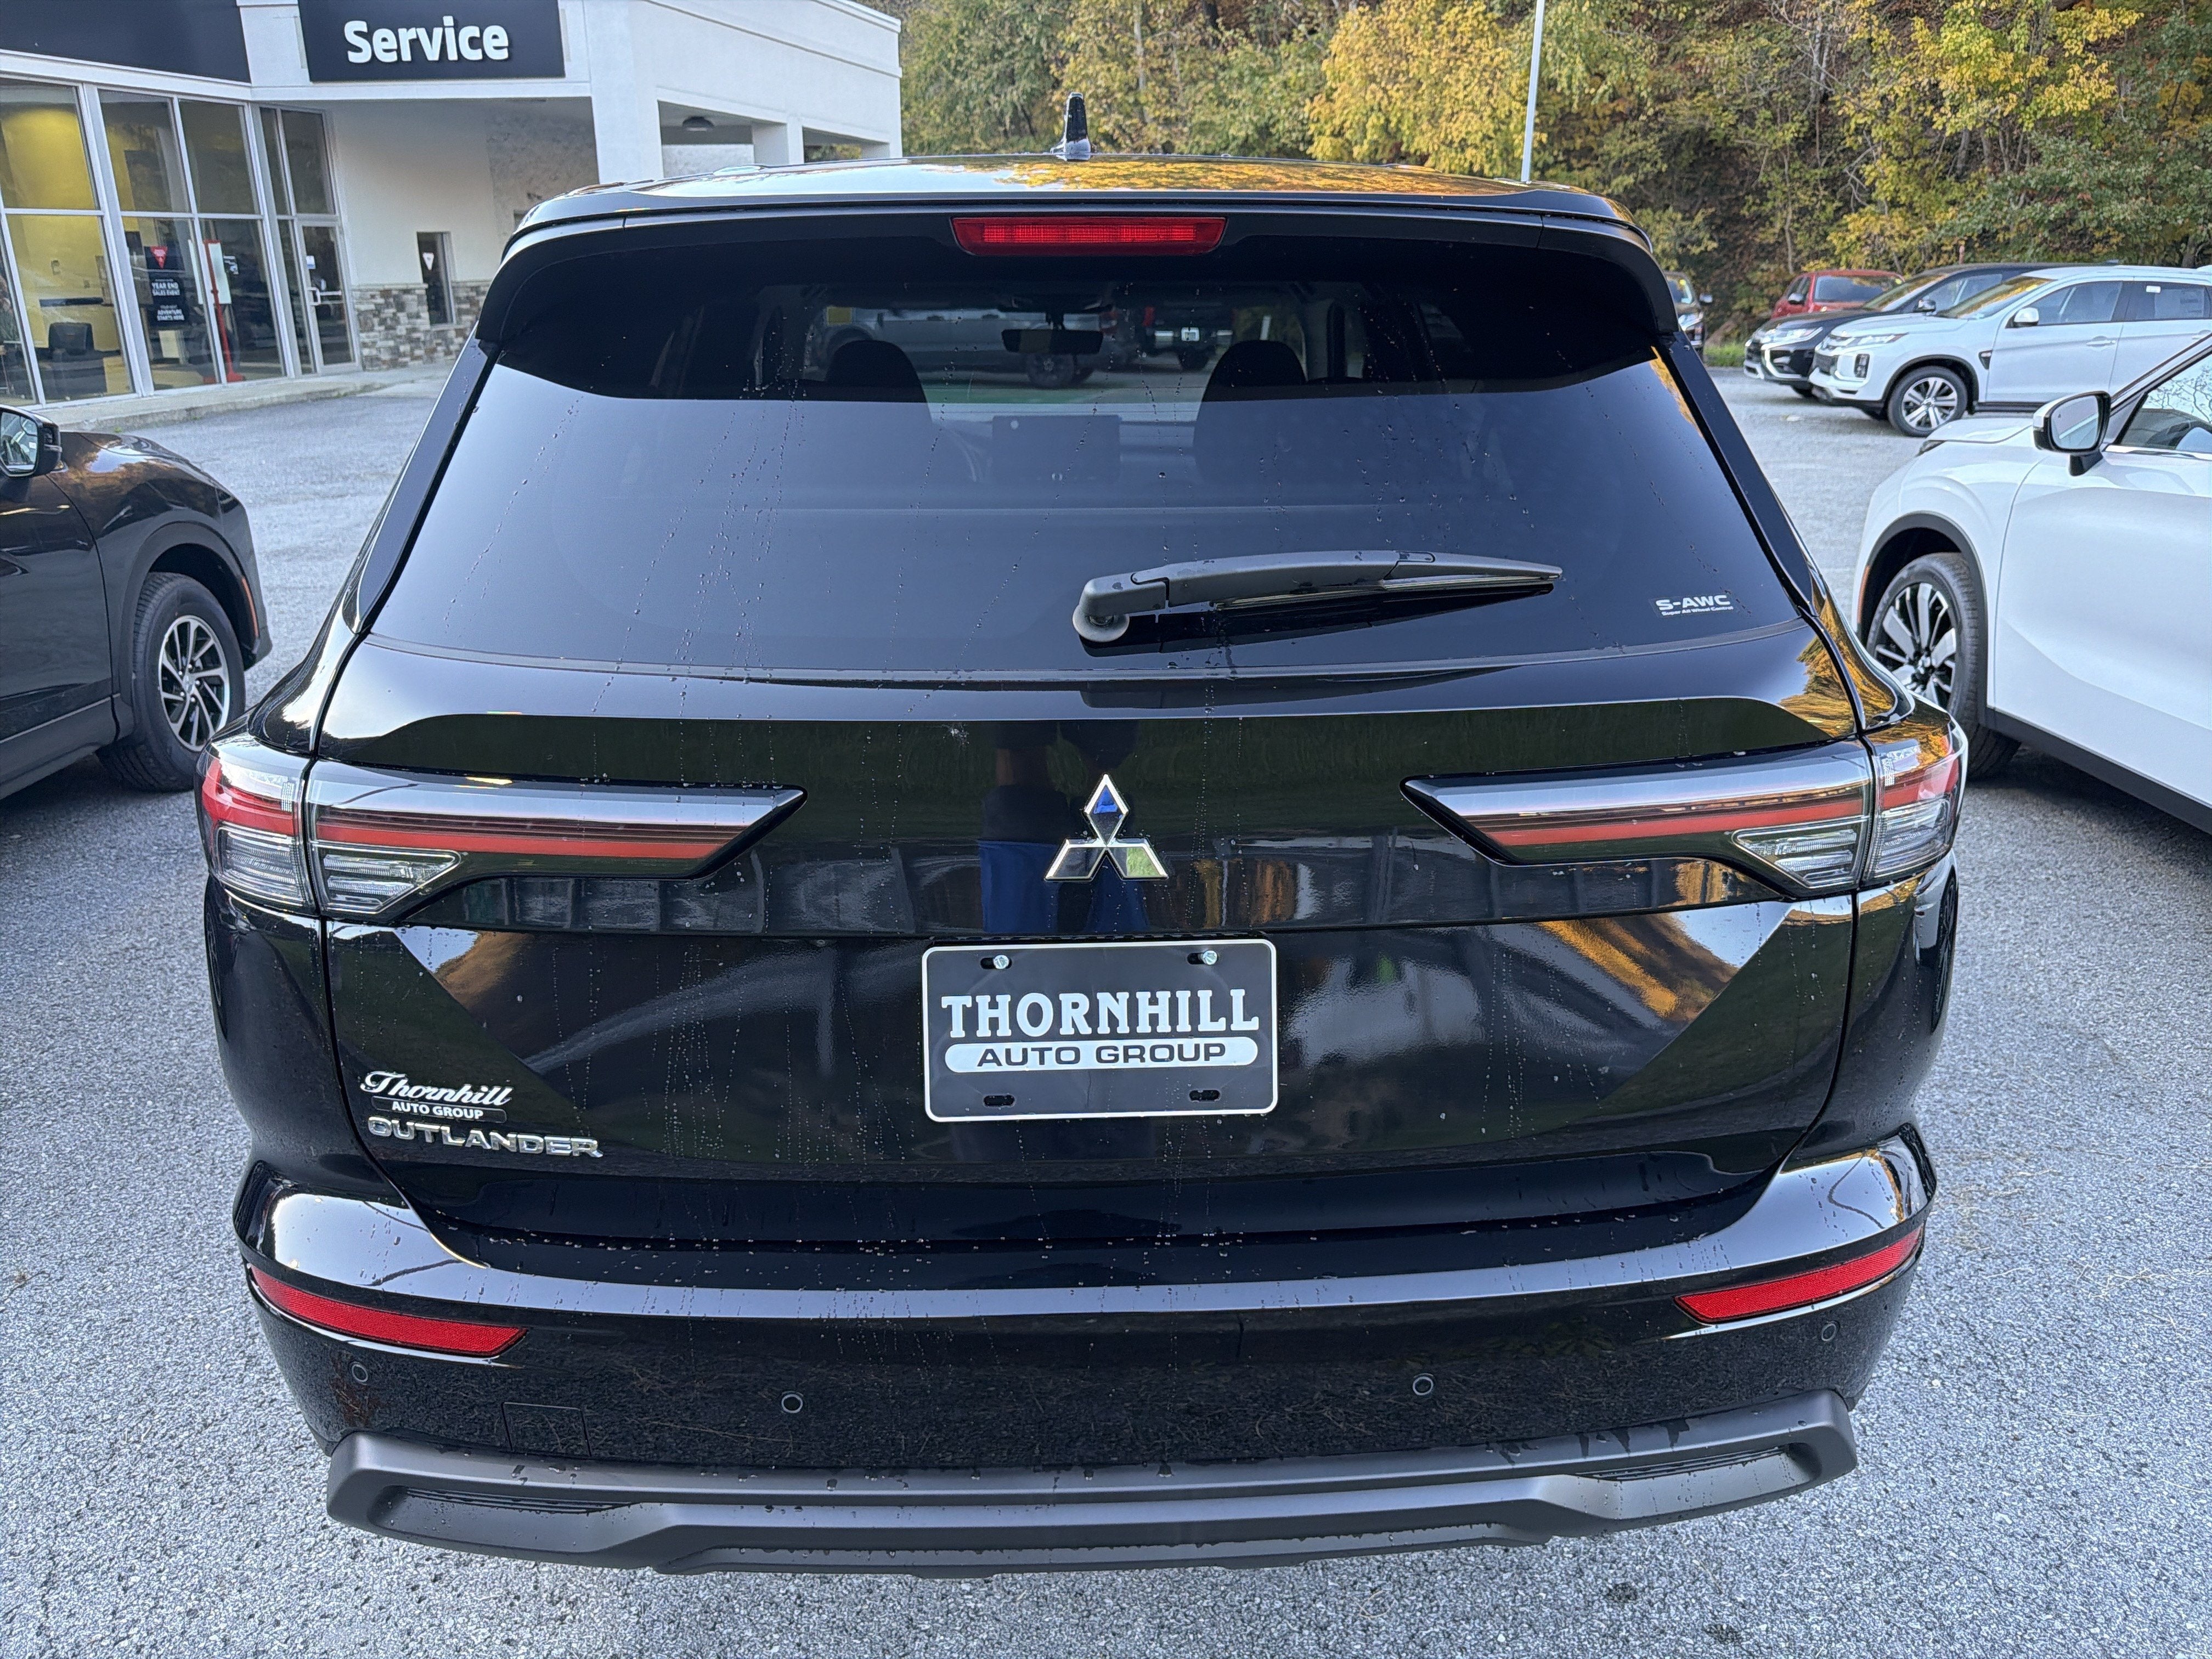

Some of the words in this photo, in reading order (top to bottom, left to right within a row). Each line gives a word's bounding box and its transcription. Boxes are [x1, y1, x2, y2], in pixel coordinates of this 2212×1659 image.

[345, 15, 509, 63] Service
[1656, 595, 1731, 611] S-AWC
[941, 989, 1259, 1038] THORNHILL
[977, 1046, 1081, 1068] AUTO
[1096, 1043, 1226, 1064] GROUP
[360, 1070, 514, 1107] Thornhill
[392, 1100, 430, 1115] AUTO
[432, 1105, 484, 1120] GROUP
[368, 1116, 603, 1158] OUTLANDER
